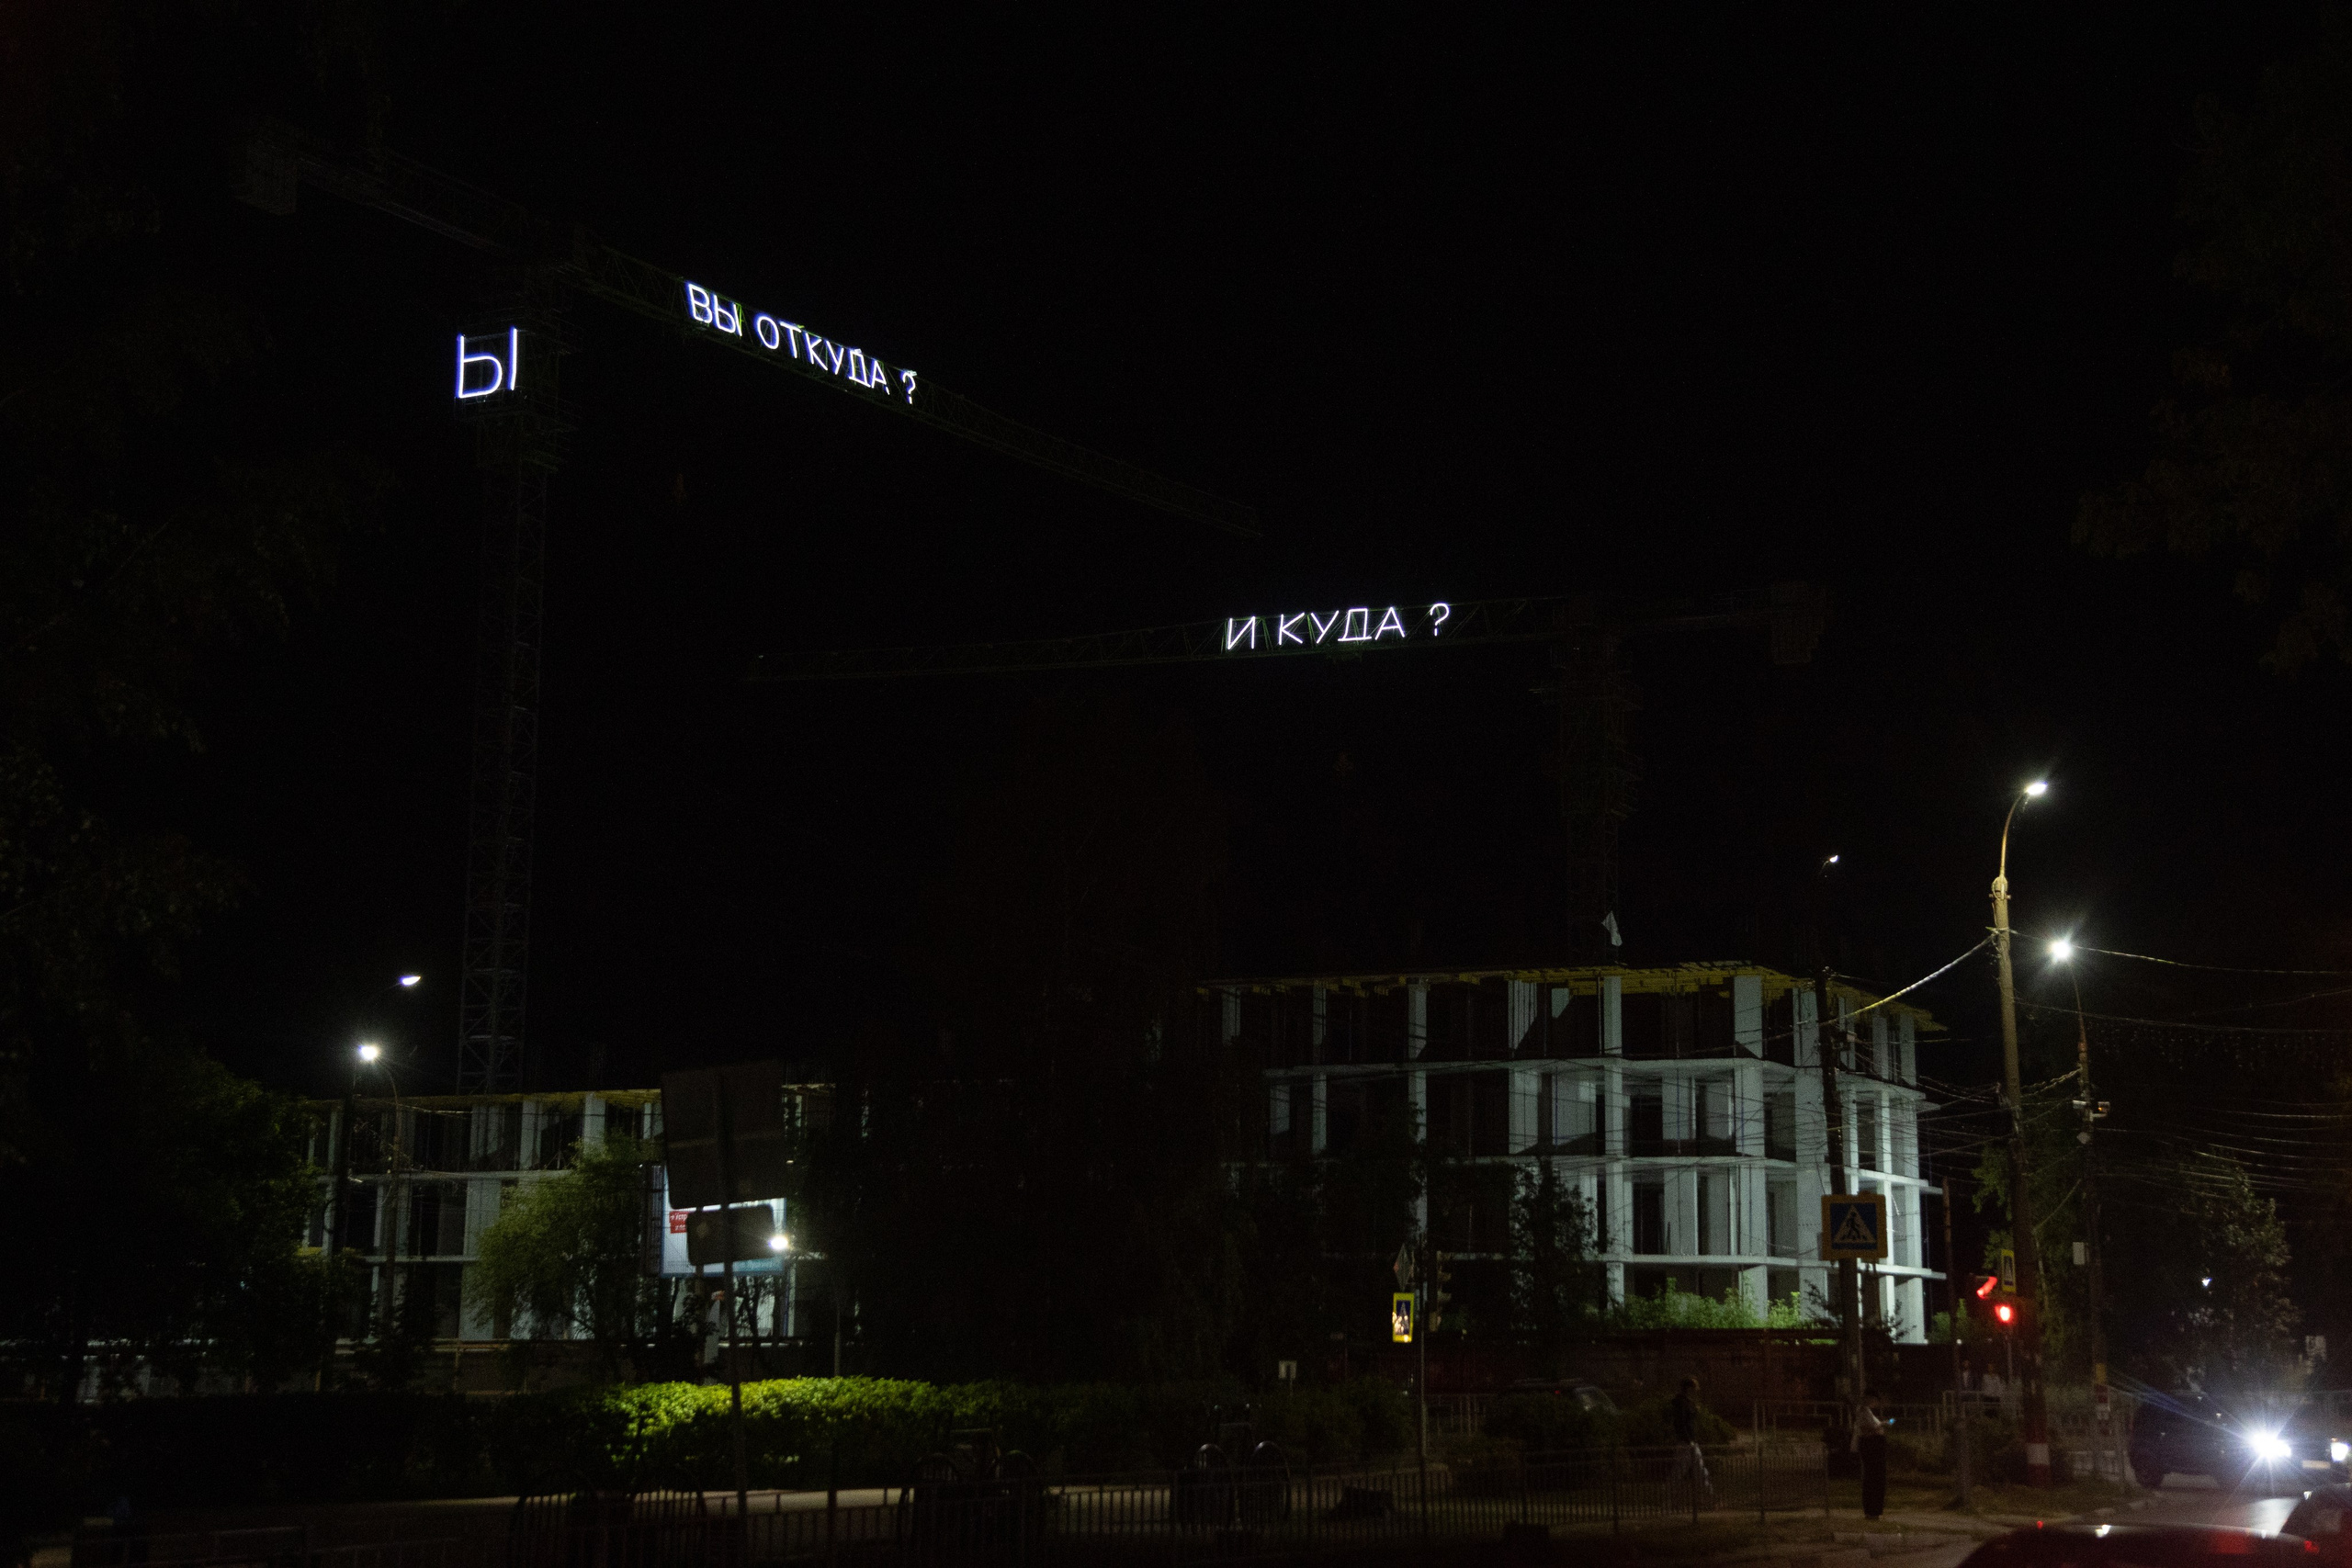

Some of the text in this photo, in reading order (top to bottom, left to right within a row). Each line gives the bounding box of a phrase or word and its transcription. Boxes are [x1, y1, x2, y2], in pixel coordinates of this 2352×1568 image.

[455, 327, 517, 400] Ы
[686, 282, 917, 404] ВЫ ОТКУДА ?
[1226, 603, 1450, 649] И КУДА ?
